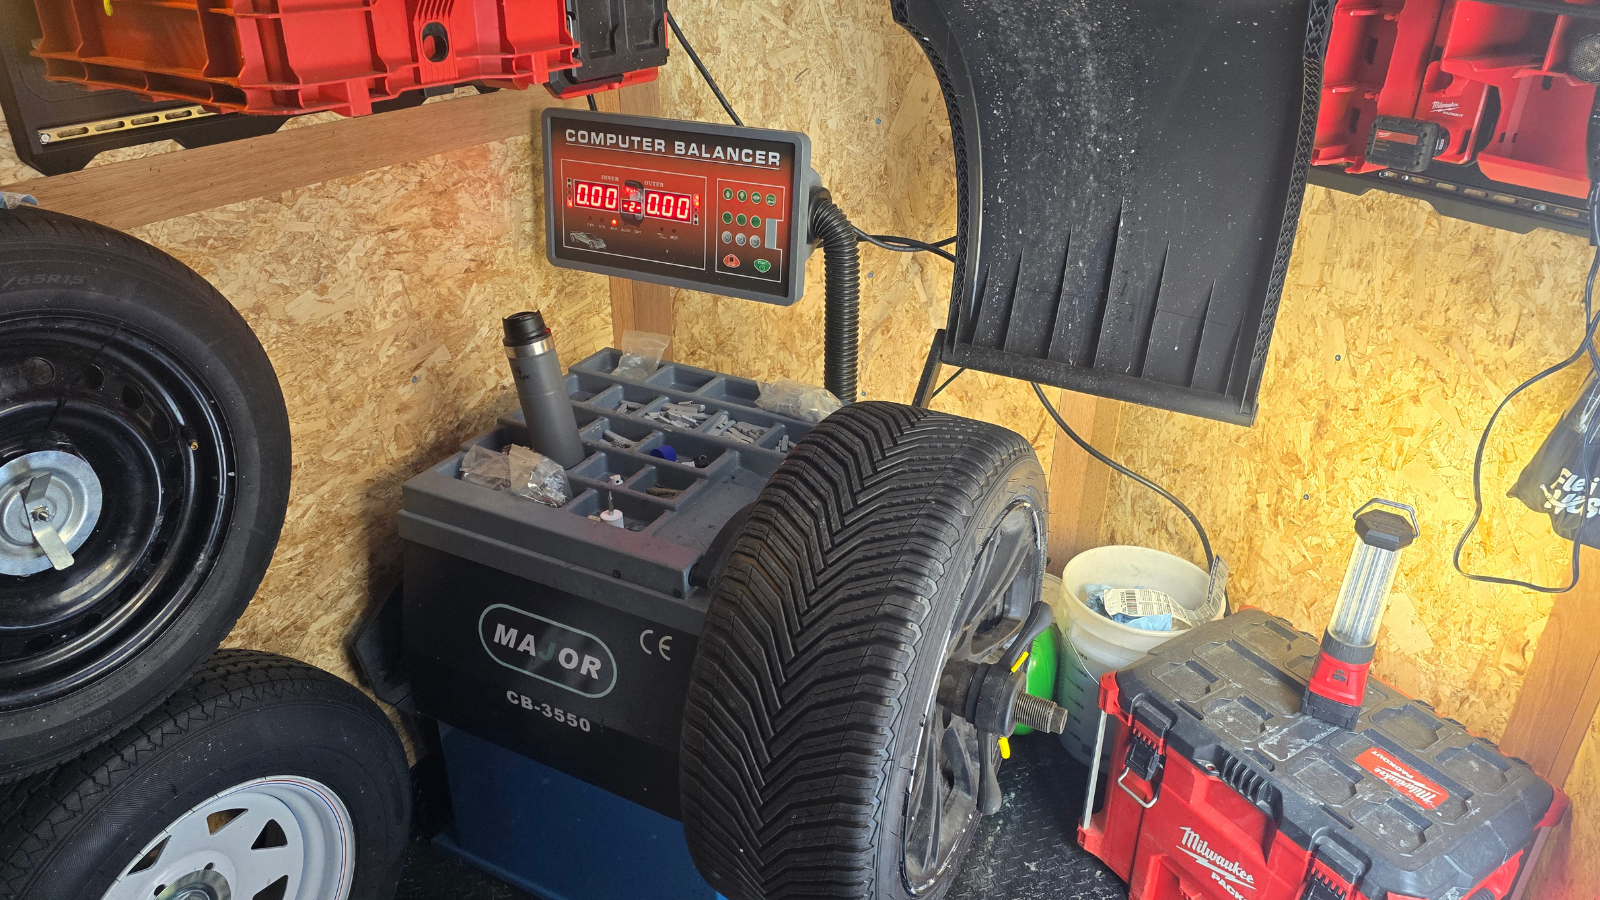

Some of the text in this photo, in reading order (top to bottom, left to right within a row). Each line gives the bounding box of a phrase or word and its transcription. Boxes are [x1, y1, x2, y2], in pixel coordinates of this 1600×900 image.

[1431, 100, 1459, 109] Milwaukee
[565, 128, 781, 166] COMPUTER BALANCER
[600, 174, 619, 182] INNER
[644, 180, 664, 188] OUTER
[576, 183, 618, 209] 0.00
[646, 193, 690, 220] 0.00
[493, 623, 601, 680] MAJOR
[506, 690, 591, 732] CB-3550
[1371, 750, 1415, 779] PACKOUT
[1374, 766, 1437, 806] Milwaukee
[1179, 826, 1255, 884] Milwaukee
